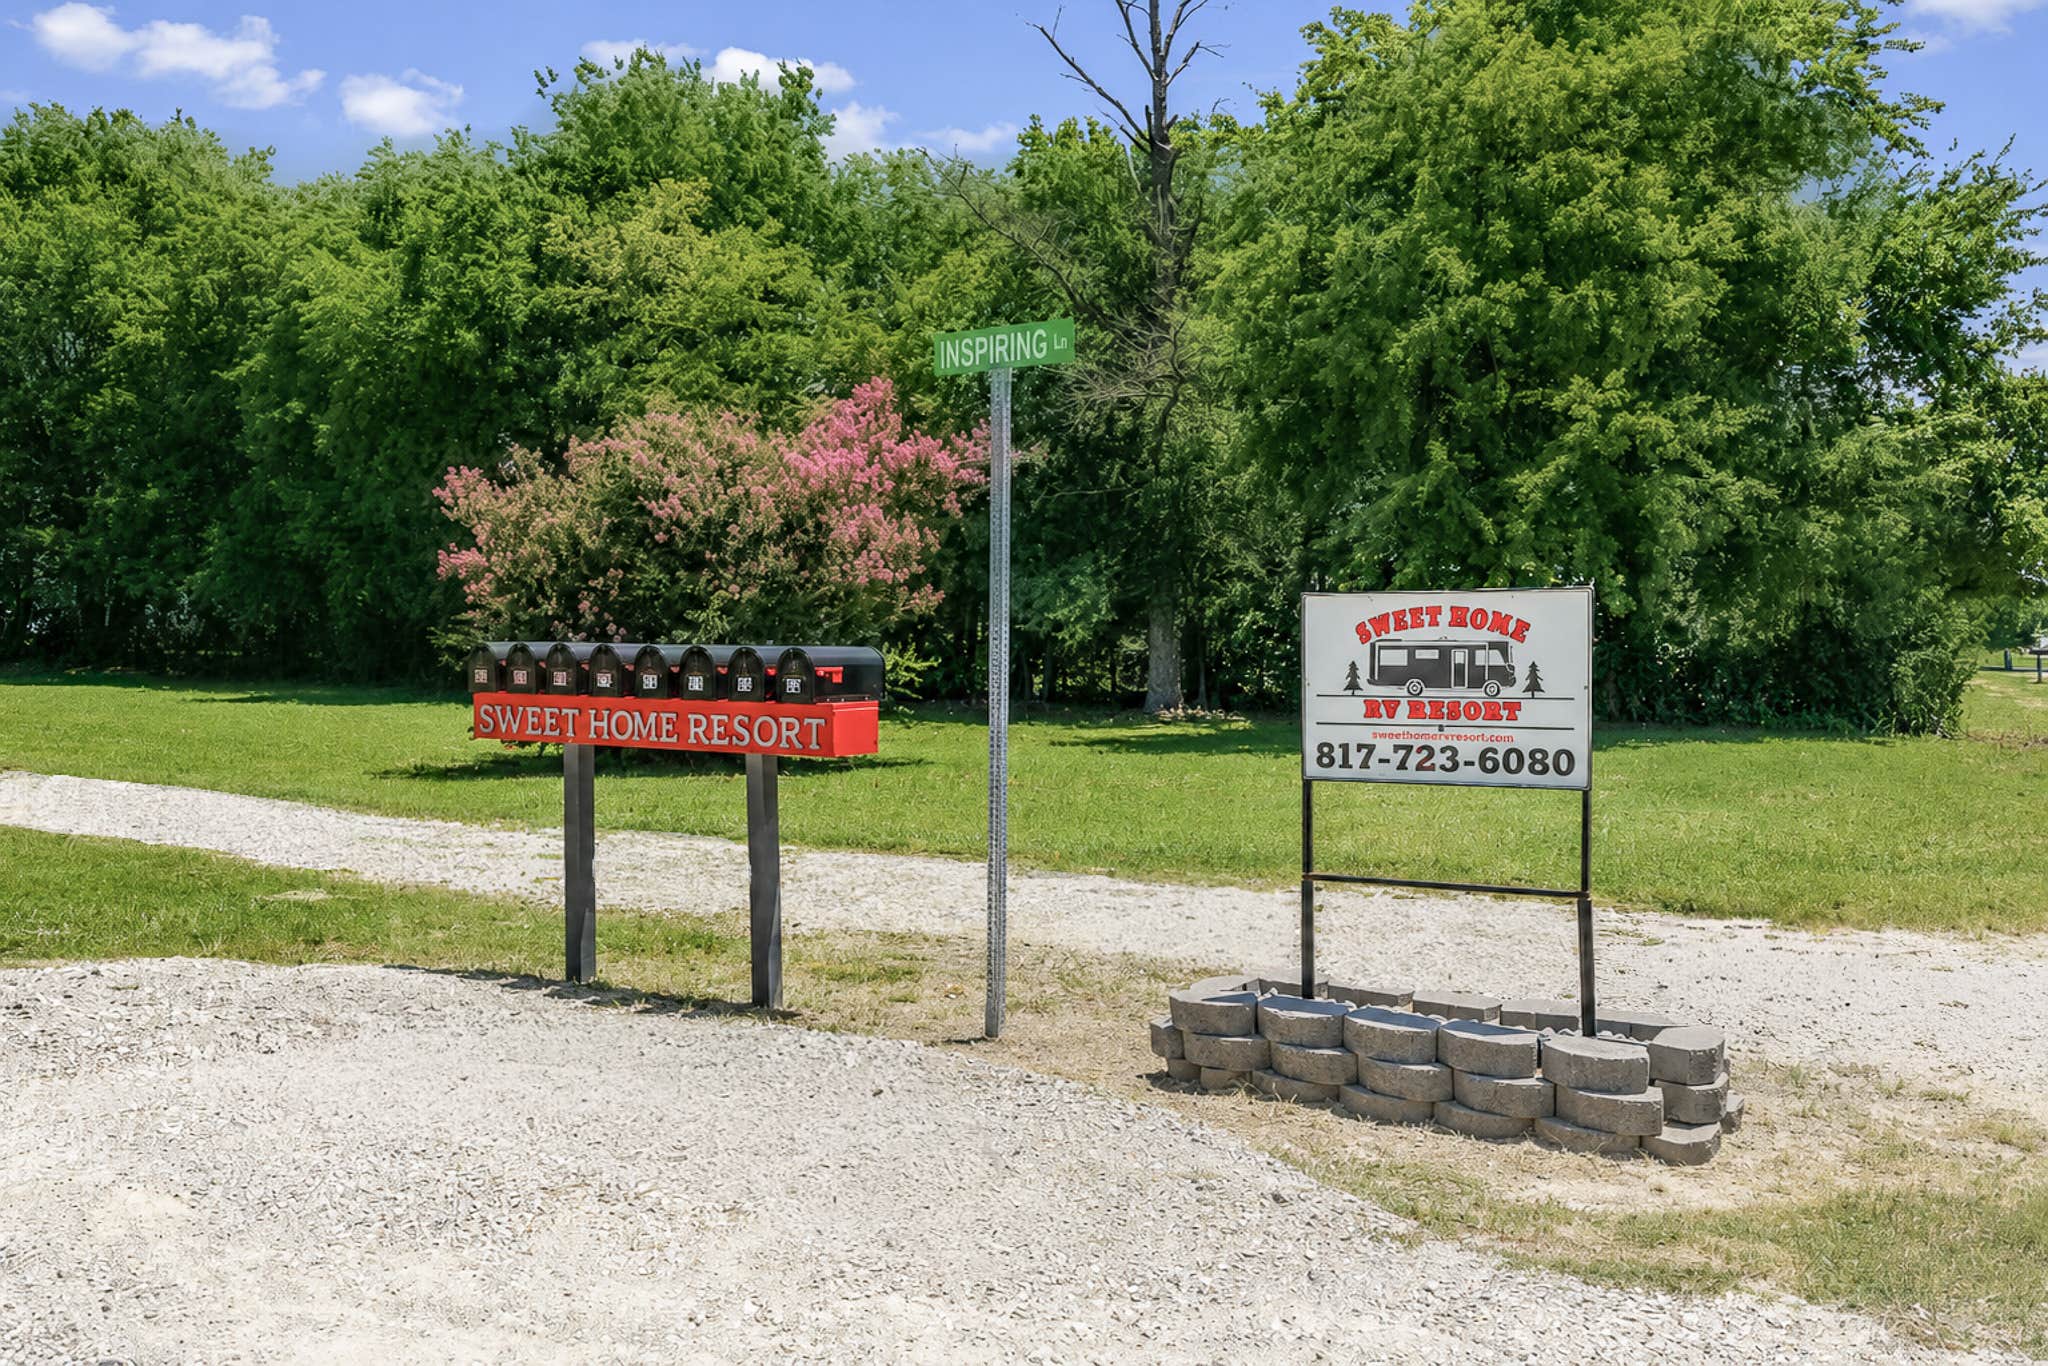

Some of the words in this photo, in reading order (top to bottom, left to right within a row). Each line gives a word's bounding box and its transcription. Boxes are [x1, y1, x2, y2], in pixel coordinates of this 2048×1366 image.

[940, 329, 1047, 369] INSPIRING
[1053, 333, 1068, 350] Ln
[1355, 605, 1442, 645] SWEET
[1449, 605, 1531, 644] HOME
[479, 703, 580, 737] SWEET
[588, 709, 678, 743] HOME
[687, 713, 826, 750] RESORT
[1363, 699, 1400, 719] RV
[1407, 700, 1522, 721] RESORT
[1316, 742, 1575, 776] 817-723-6080
